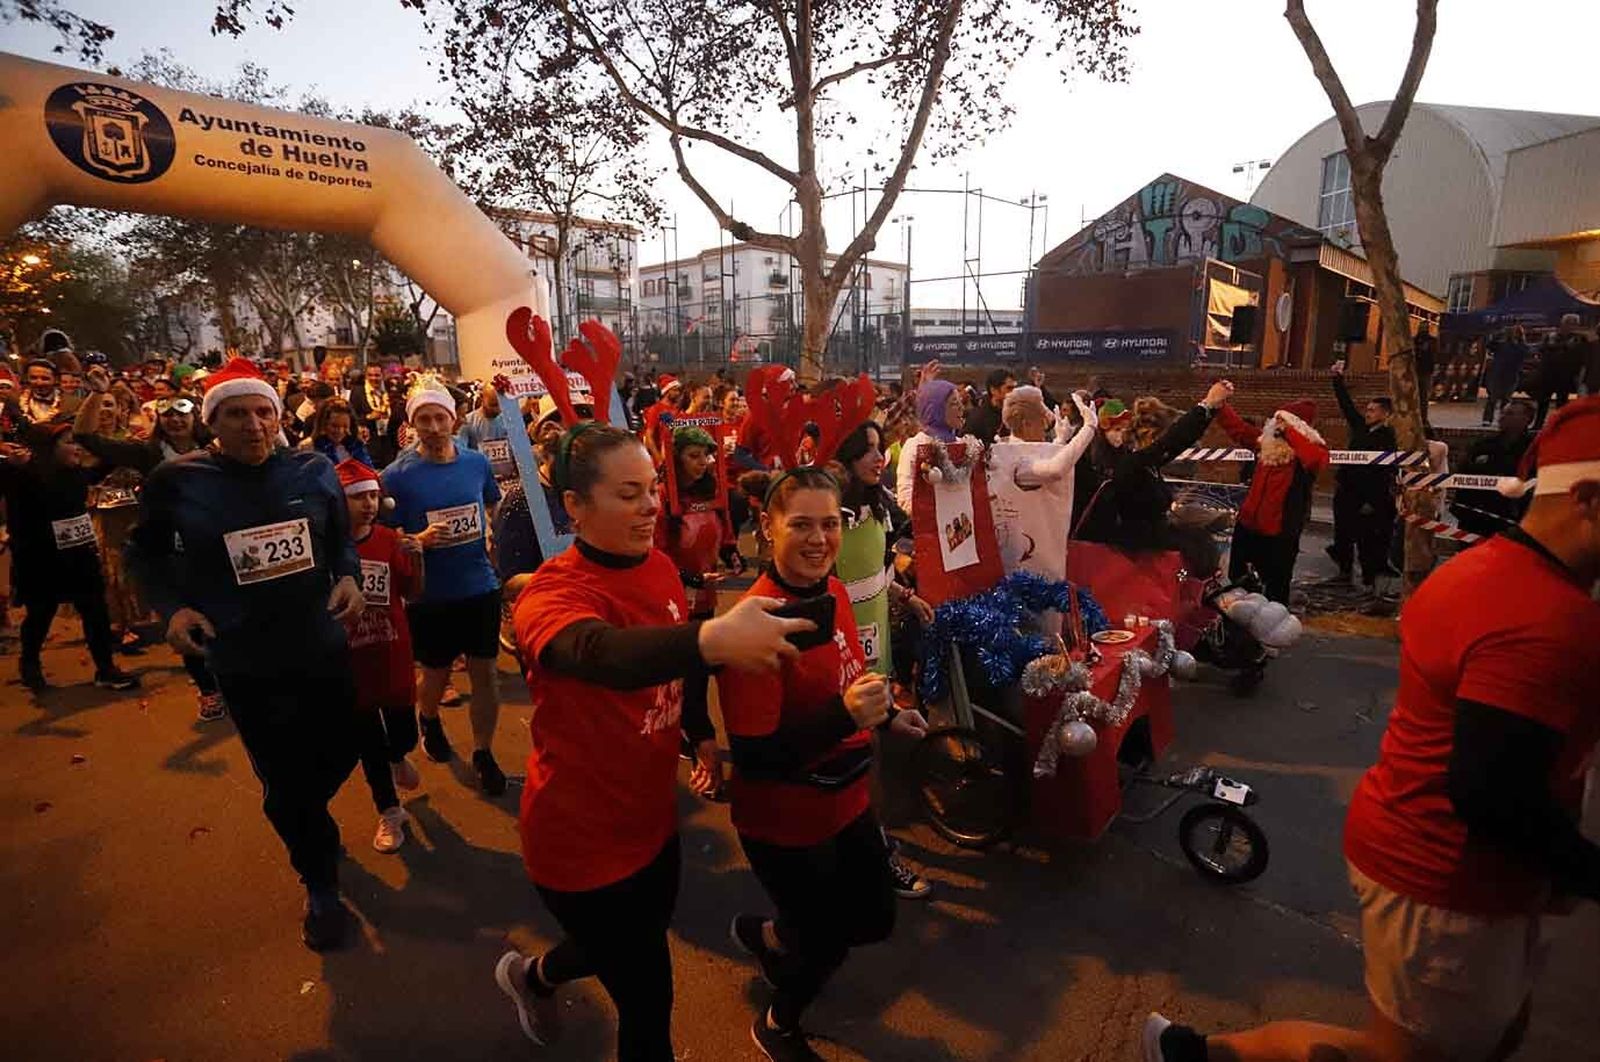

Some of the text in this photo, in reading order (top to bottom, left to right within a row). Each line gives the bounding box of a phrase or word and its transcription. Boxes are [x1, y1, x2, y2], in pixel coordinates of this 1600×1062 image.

[179, 107, 366, 152] Ayuntamiento
[240, 138, 368, 172] de Huelva
[285, 167, 304, 180] de
[309, 171, 372, 189] Deportes
[1051, 338, 1092, 348] HYUNDAI
[1121, 338, 1168, 347] HYUNDAI
[452, 515, 477, 534] 234
[264, 536, 304, 562] 233
[367, 574, 386, 592] 35
